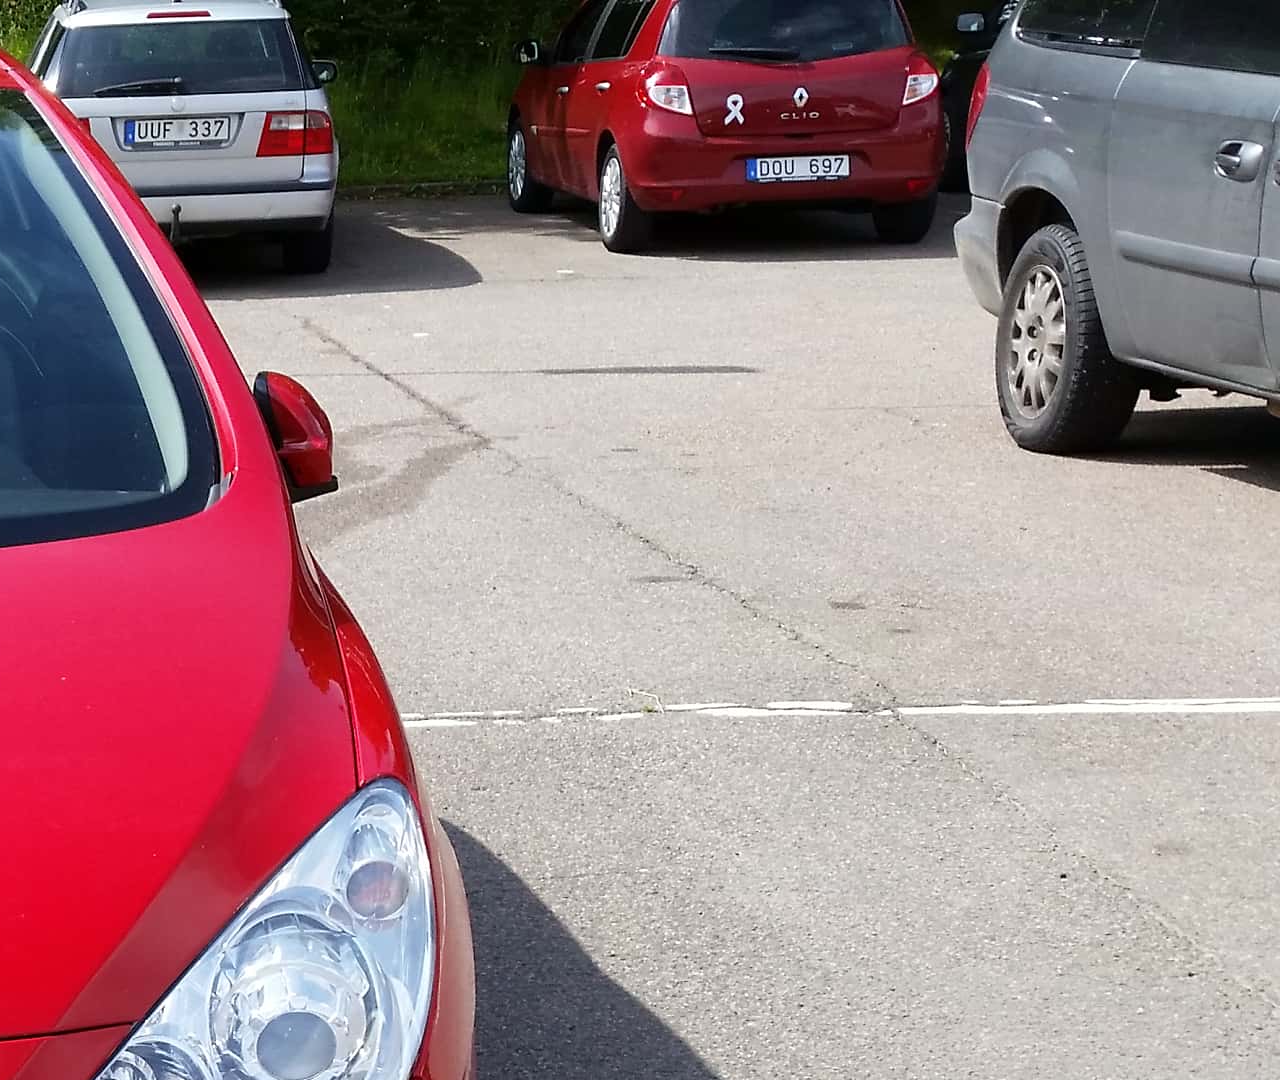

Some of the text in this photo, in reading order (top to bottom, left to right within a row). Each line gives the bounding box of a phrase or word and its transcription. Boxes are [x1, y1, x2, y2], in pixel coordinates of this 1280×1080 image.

[780, 111, 820, 120] CLIO
[137, 120, 225, 140] UUF 337
[759, 157, 845, 177] DOU 697
